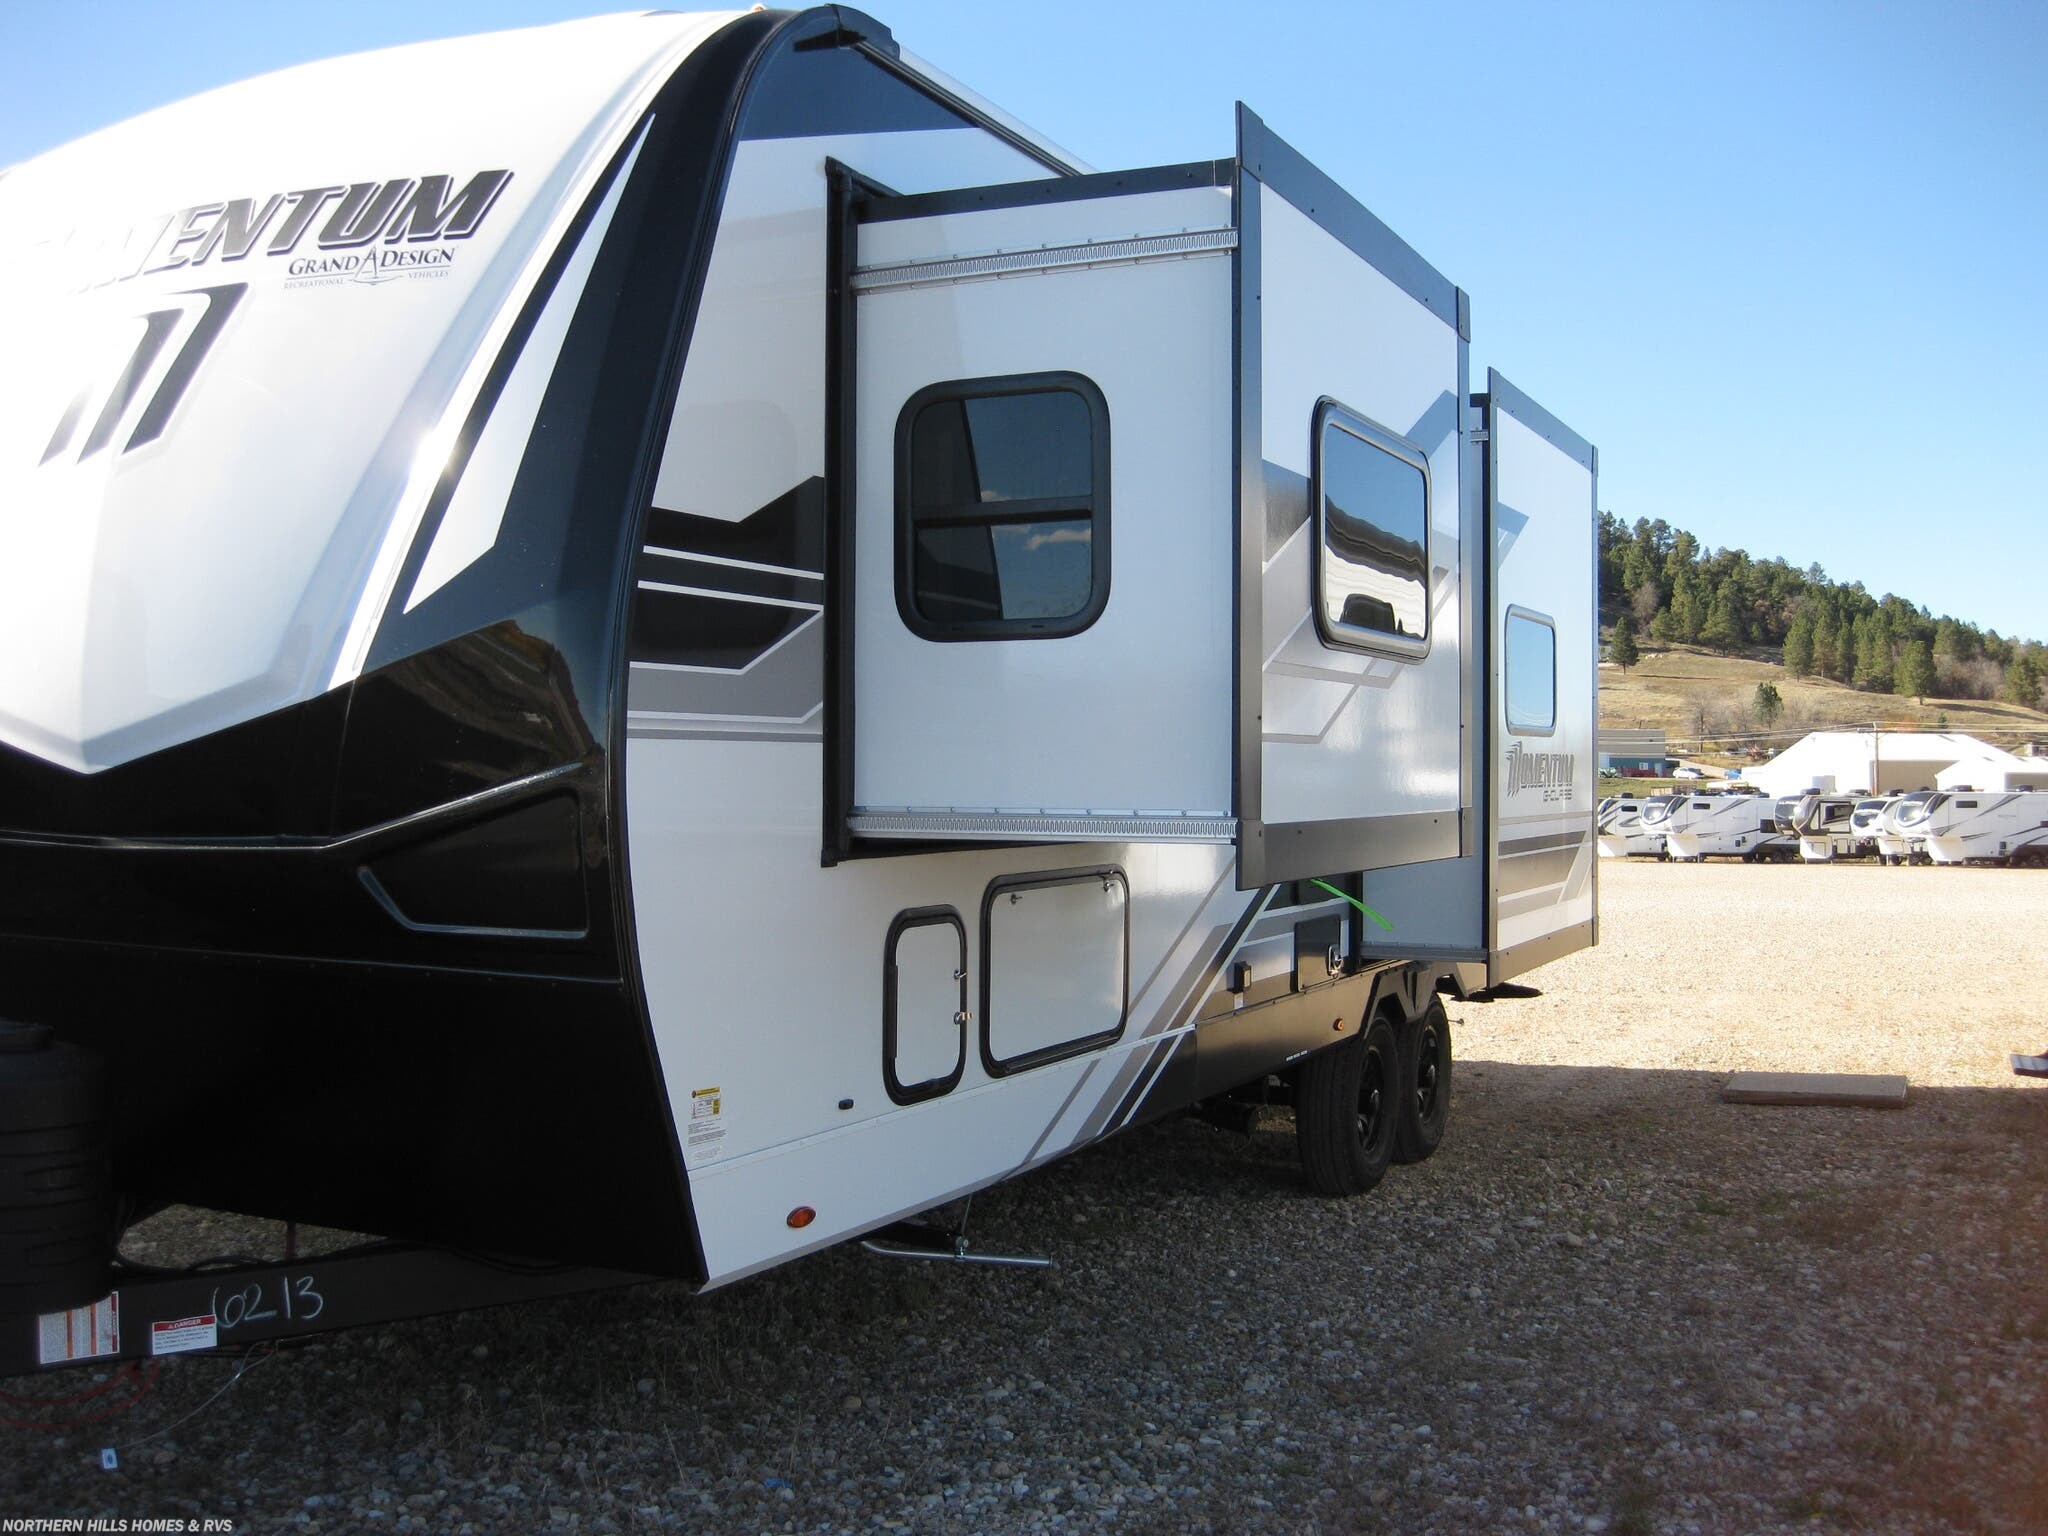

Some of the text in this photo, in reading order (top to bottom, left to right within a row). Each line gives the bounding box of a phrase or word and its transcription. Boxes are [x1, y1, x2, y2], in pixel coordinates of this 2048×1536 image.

[288, 247, 455, 276] GRAND DESIGN
[407, 270, 449, 279] VEHICLES
[174, 1318, 202, 1329] DANGER
